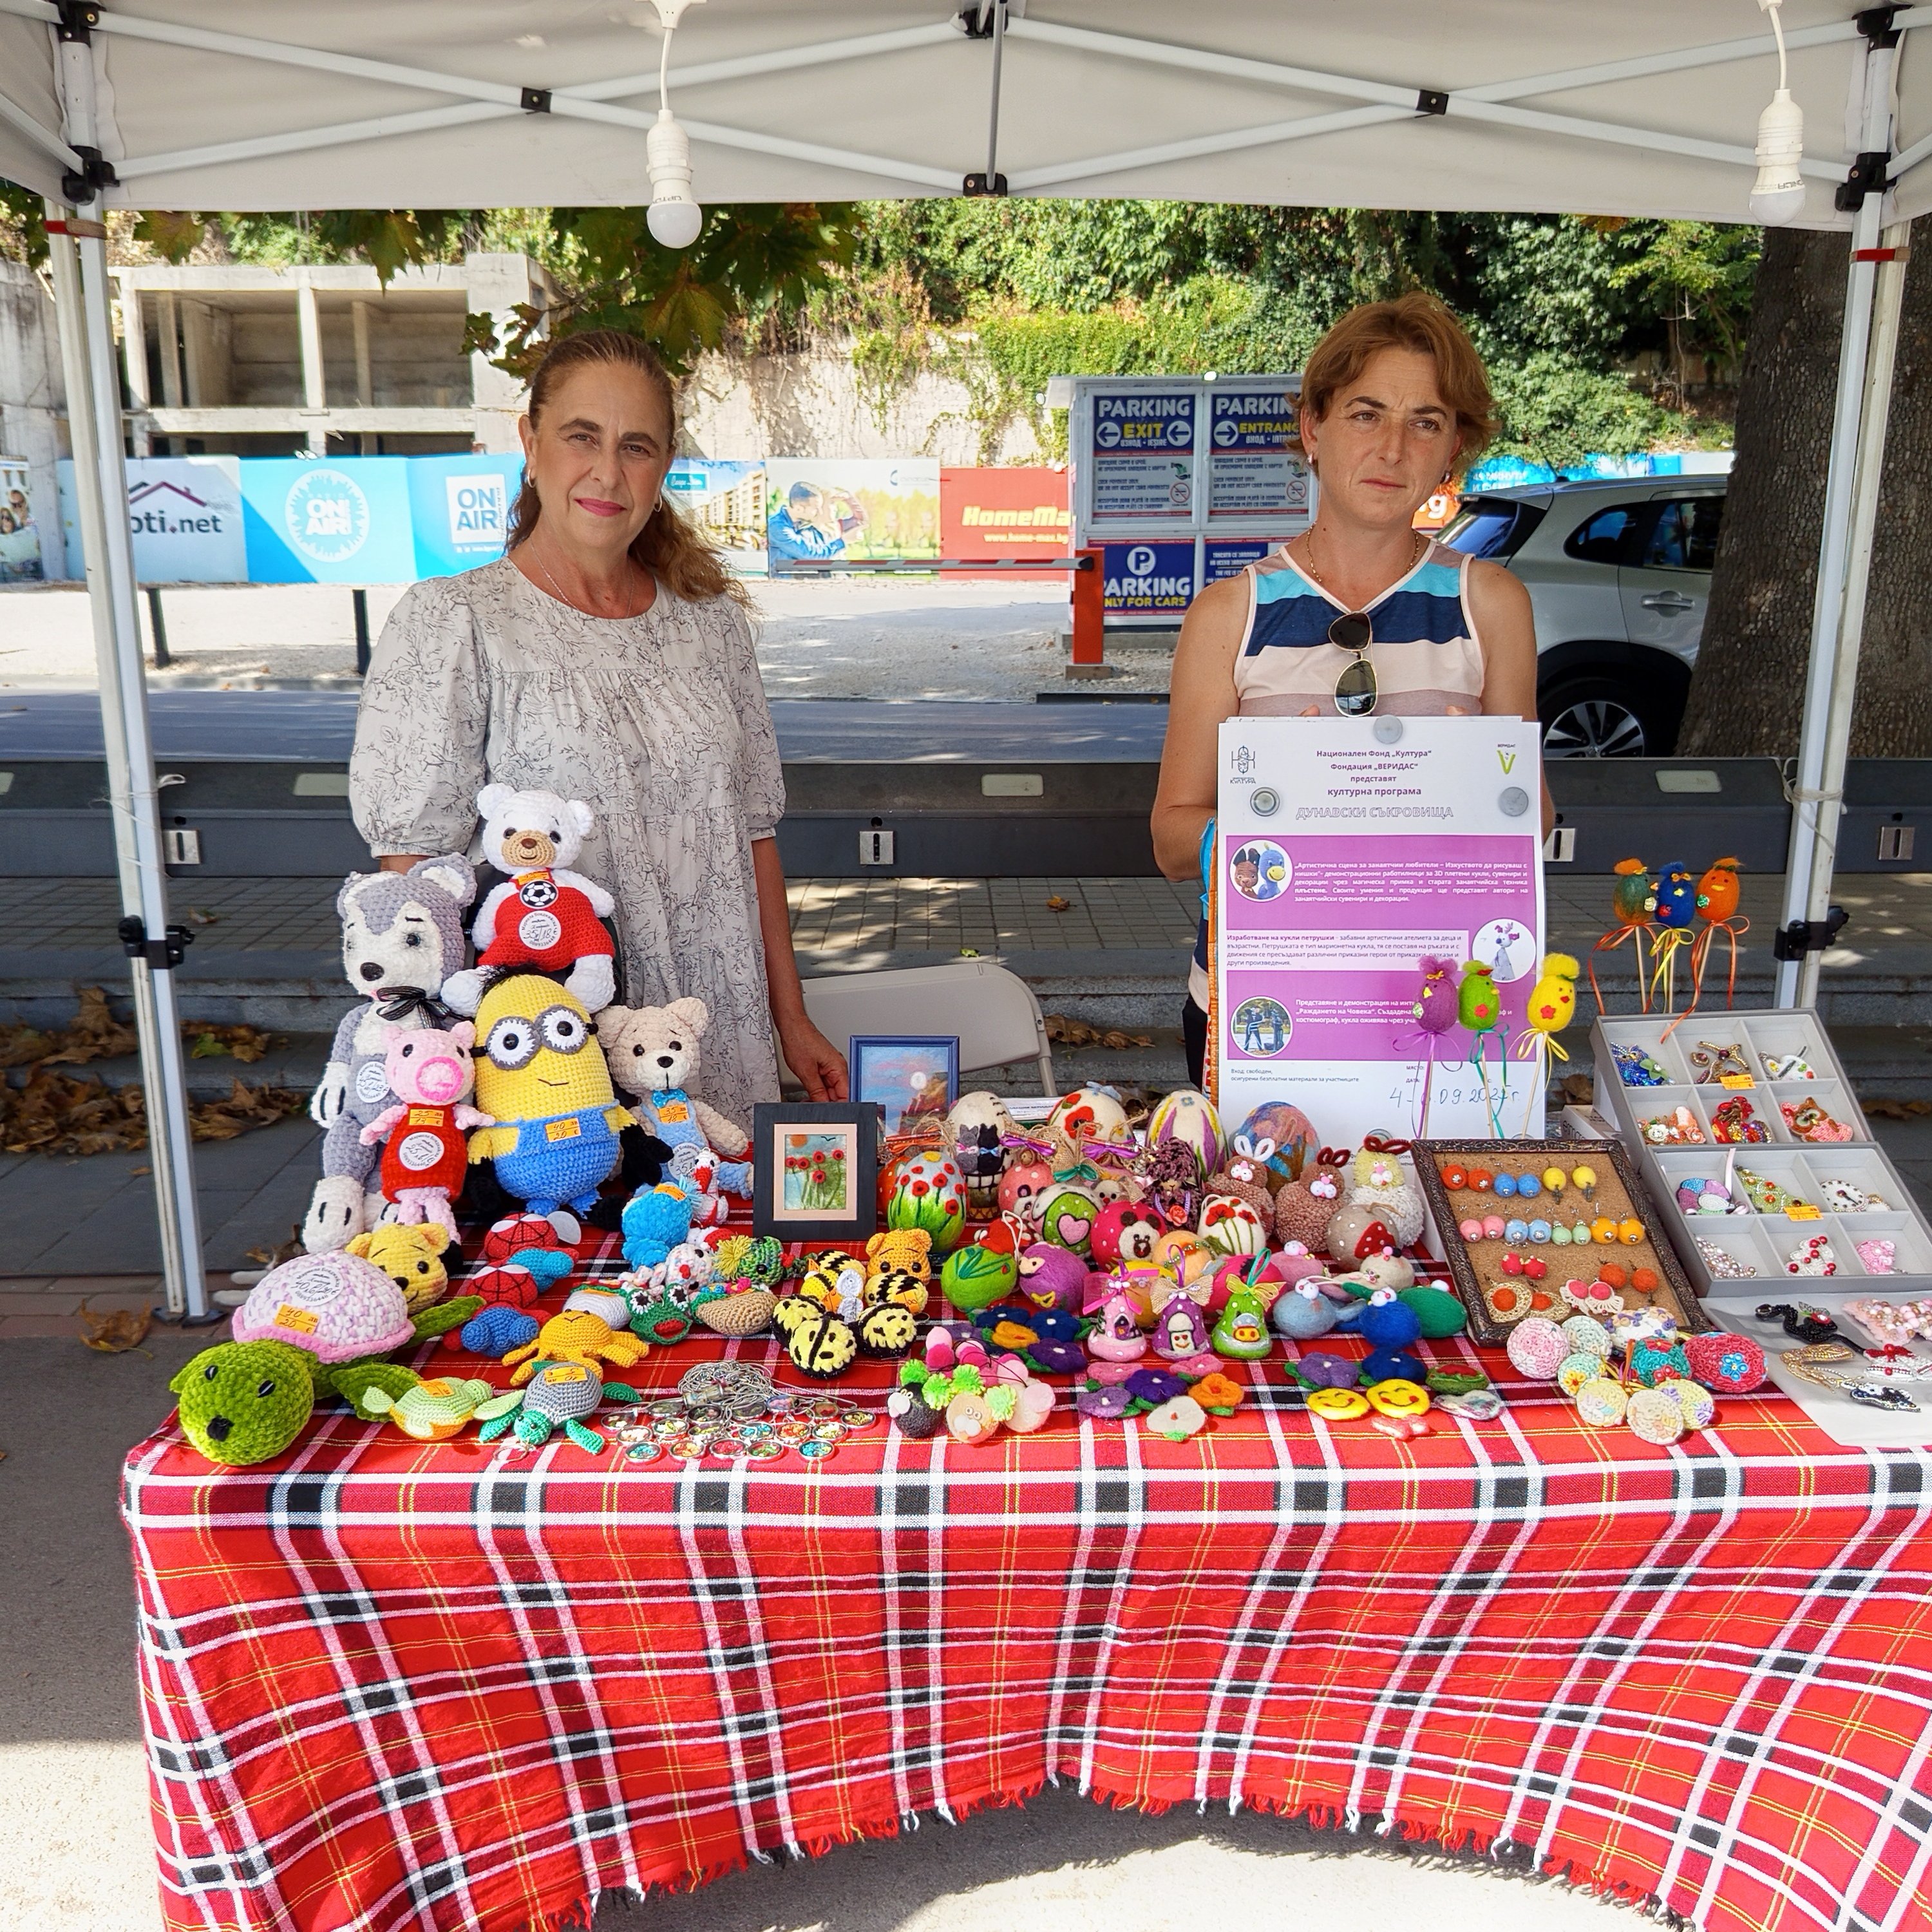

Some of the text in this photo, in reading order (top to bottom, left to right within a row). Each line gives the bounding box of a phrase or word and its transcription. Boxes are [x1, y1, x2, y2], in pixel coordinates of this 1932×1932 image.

[1098, 398, 1190, 418] PARKING
[1215, 397, 1293, 415] PARKIN
[1123, 422, 1163, 439] EXIT
[1239, 422, 1300, 433] ENTRANC
[457, 488, 496, 509] ON
[306, 498, 350, 518] ON
[305, 516, 352, 535] AIR
[457, 509, 498, 531] AIR
[1103, 578, 1190, 596] ARKING
[1104, 596, 1186, 607] NLY FOR CARS
[1316, 750, 1367, 759] Национален
[1368, 750, 1390, 759] Фонд
[1327, 789, 1421, 797] културна програма
[1296, 806, 1454, 820] ДУНАВСКИ СЪКРОВИЩА
[285, 1308, 303, 1318] 40
[279, 1318, 297, 1327] 20
